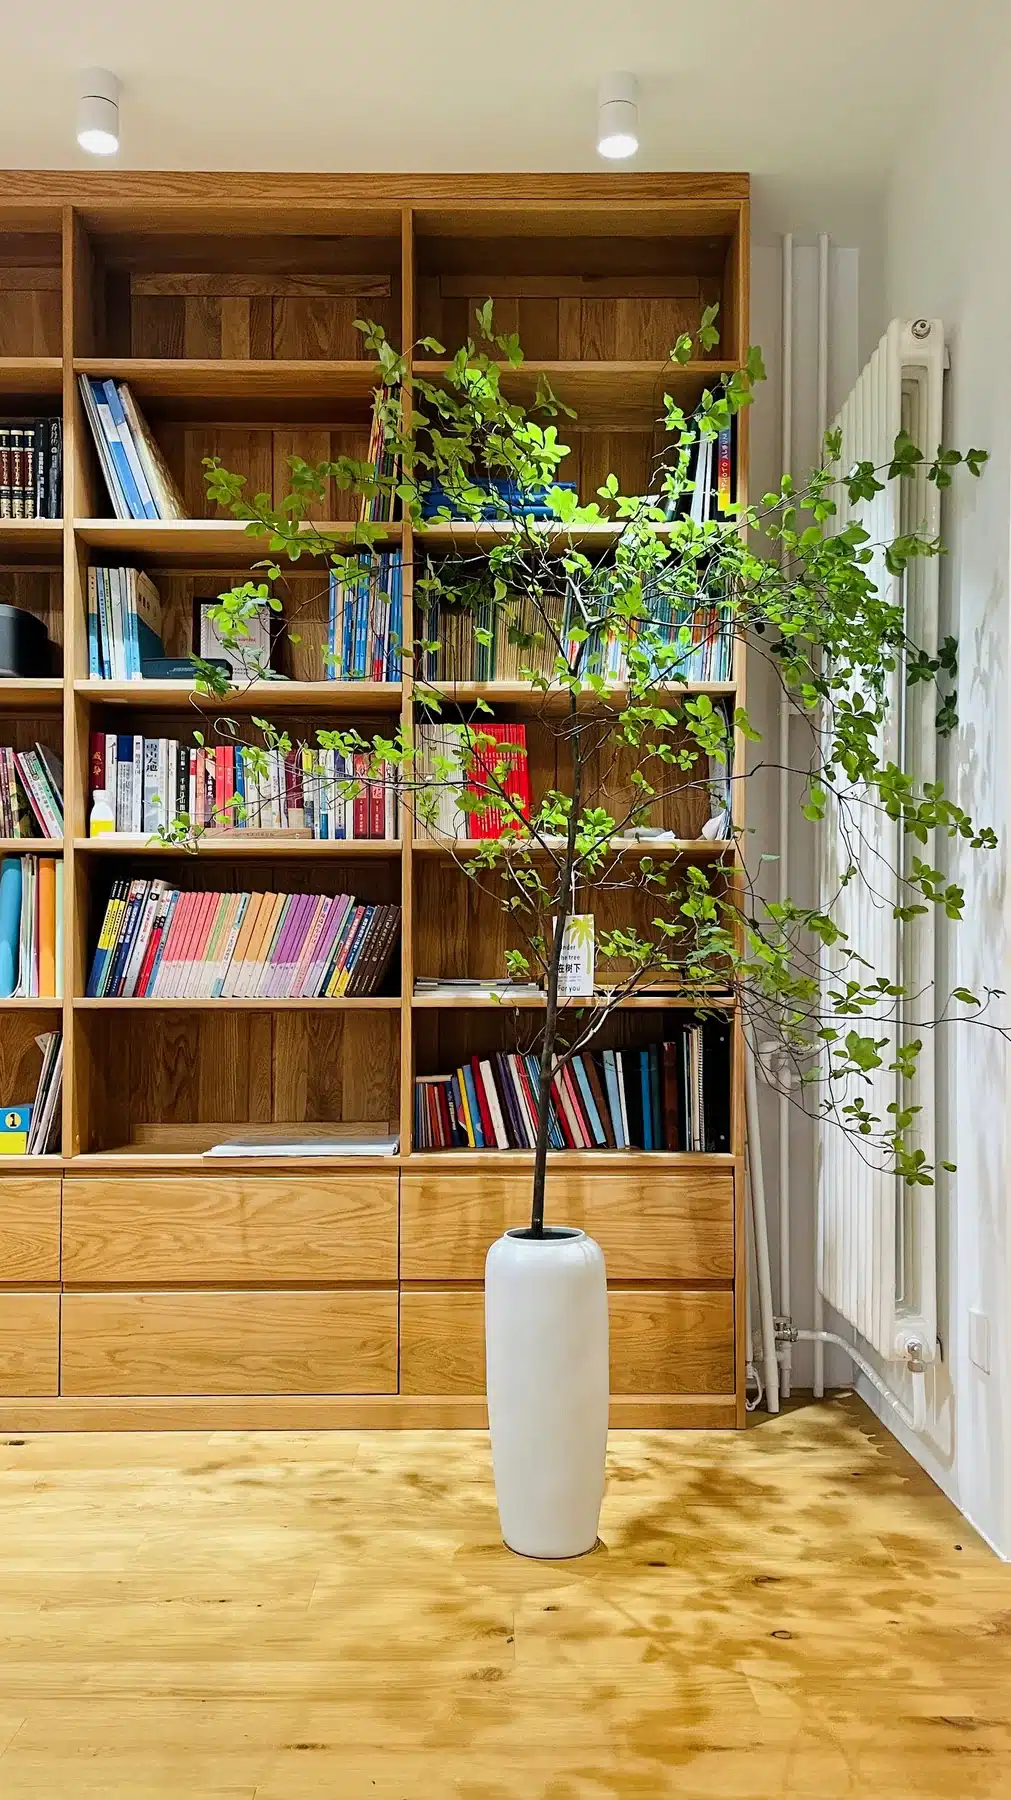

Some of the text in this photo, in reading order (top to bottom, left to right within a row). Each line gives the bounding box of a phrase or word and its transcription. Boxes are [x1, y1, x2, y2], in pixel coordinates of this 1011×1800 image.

[721, 433, 729, 459] ALBUM
[558, 963, 581, 973] 在树下
[10, 1113, 17, 1127] 1
